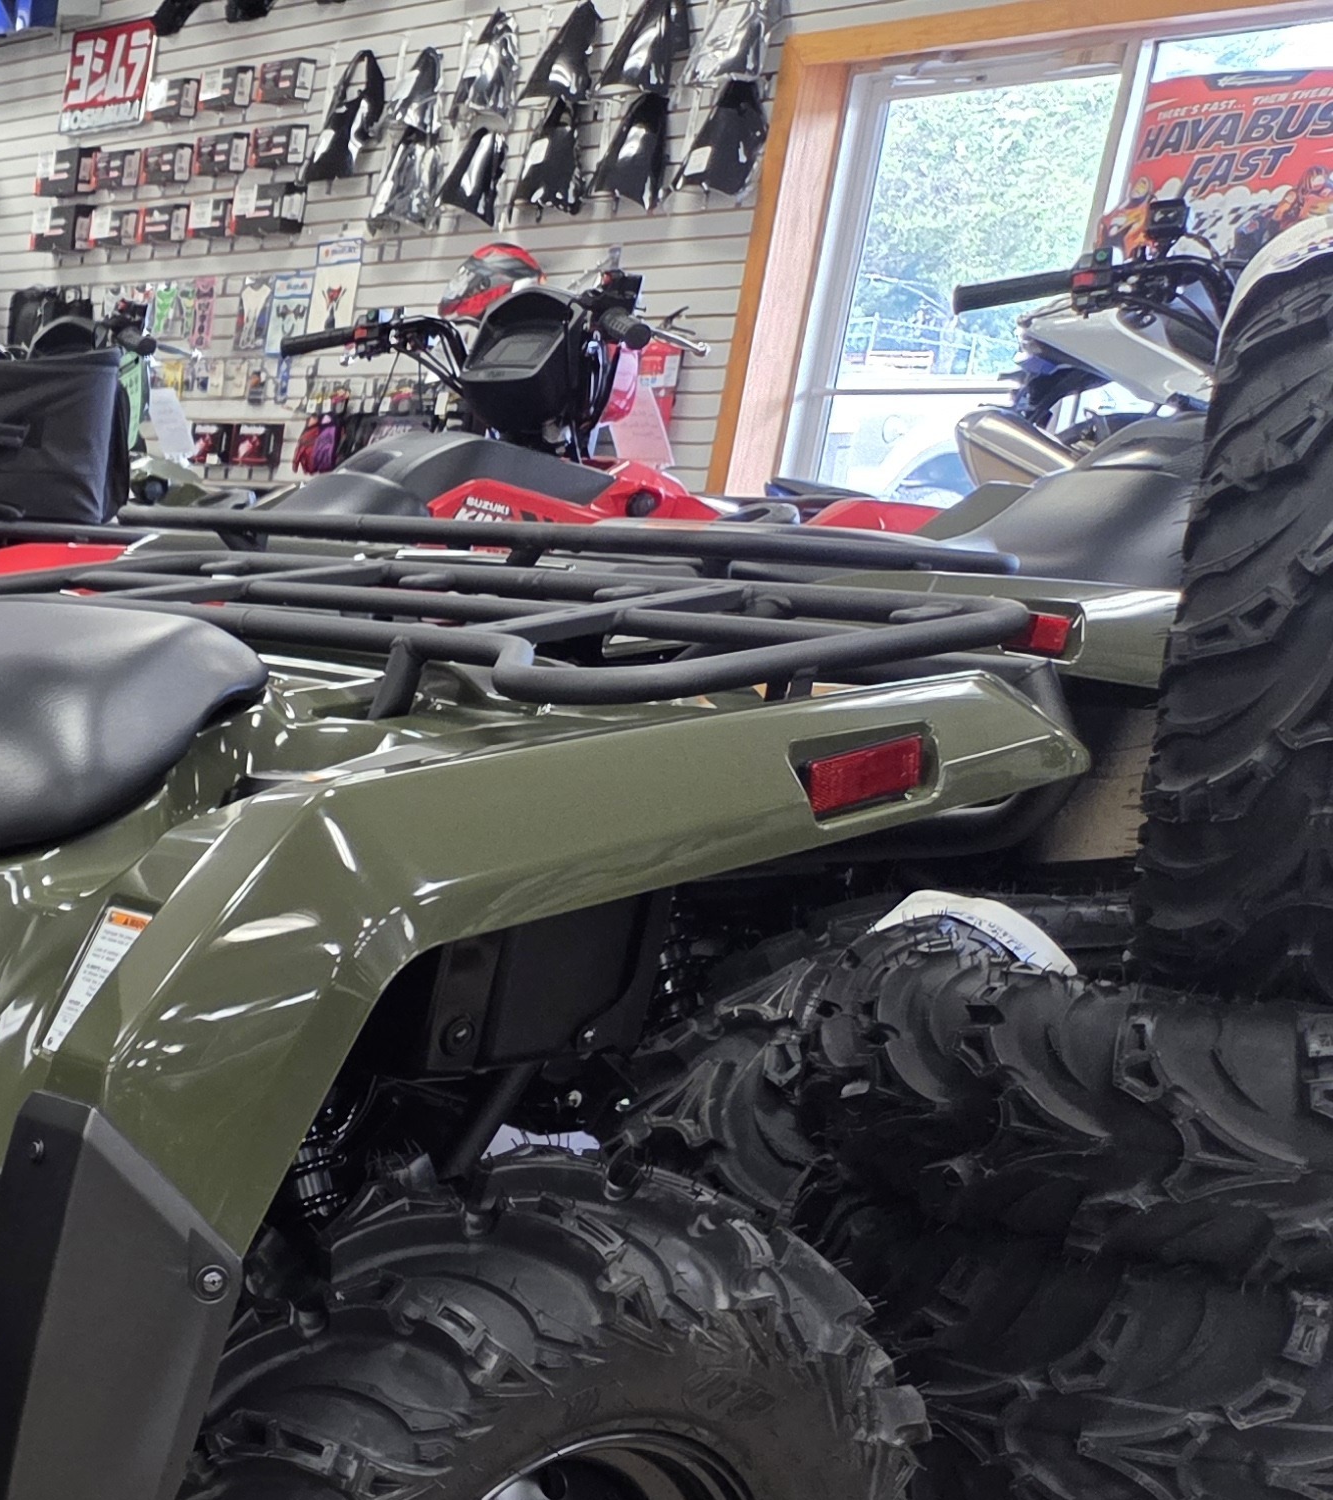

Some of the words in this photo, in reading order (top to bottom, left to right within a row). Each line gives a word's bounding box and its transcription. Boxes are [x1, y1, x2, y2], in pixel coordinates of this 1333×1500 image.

[1137, 102, 1333, 163] HAYABUS
[1183, 144, 1297, 199] FAST
[466, 496, 510, 515] SUZUKI
